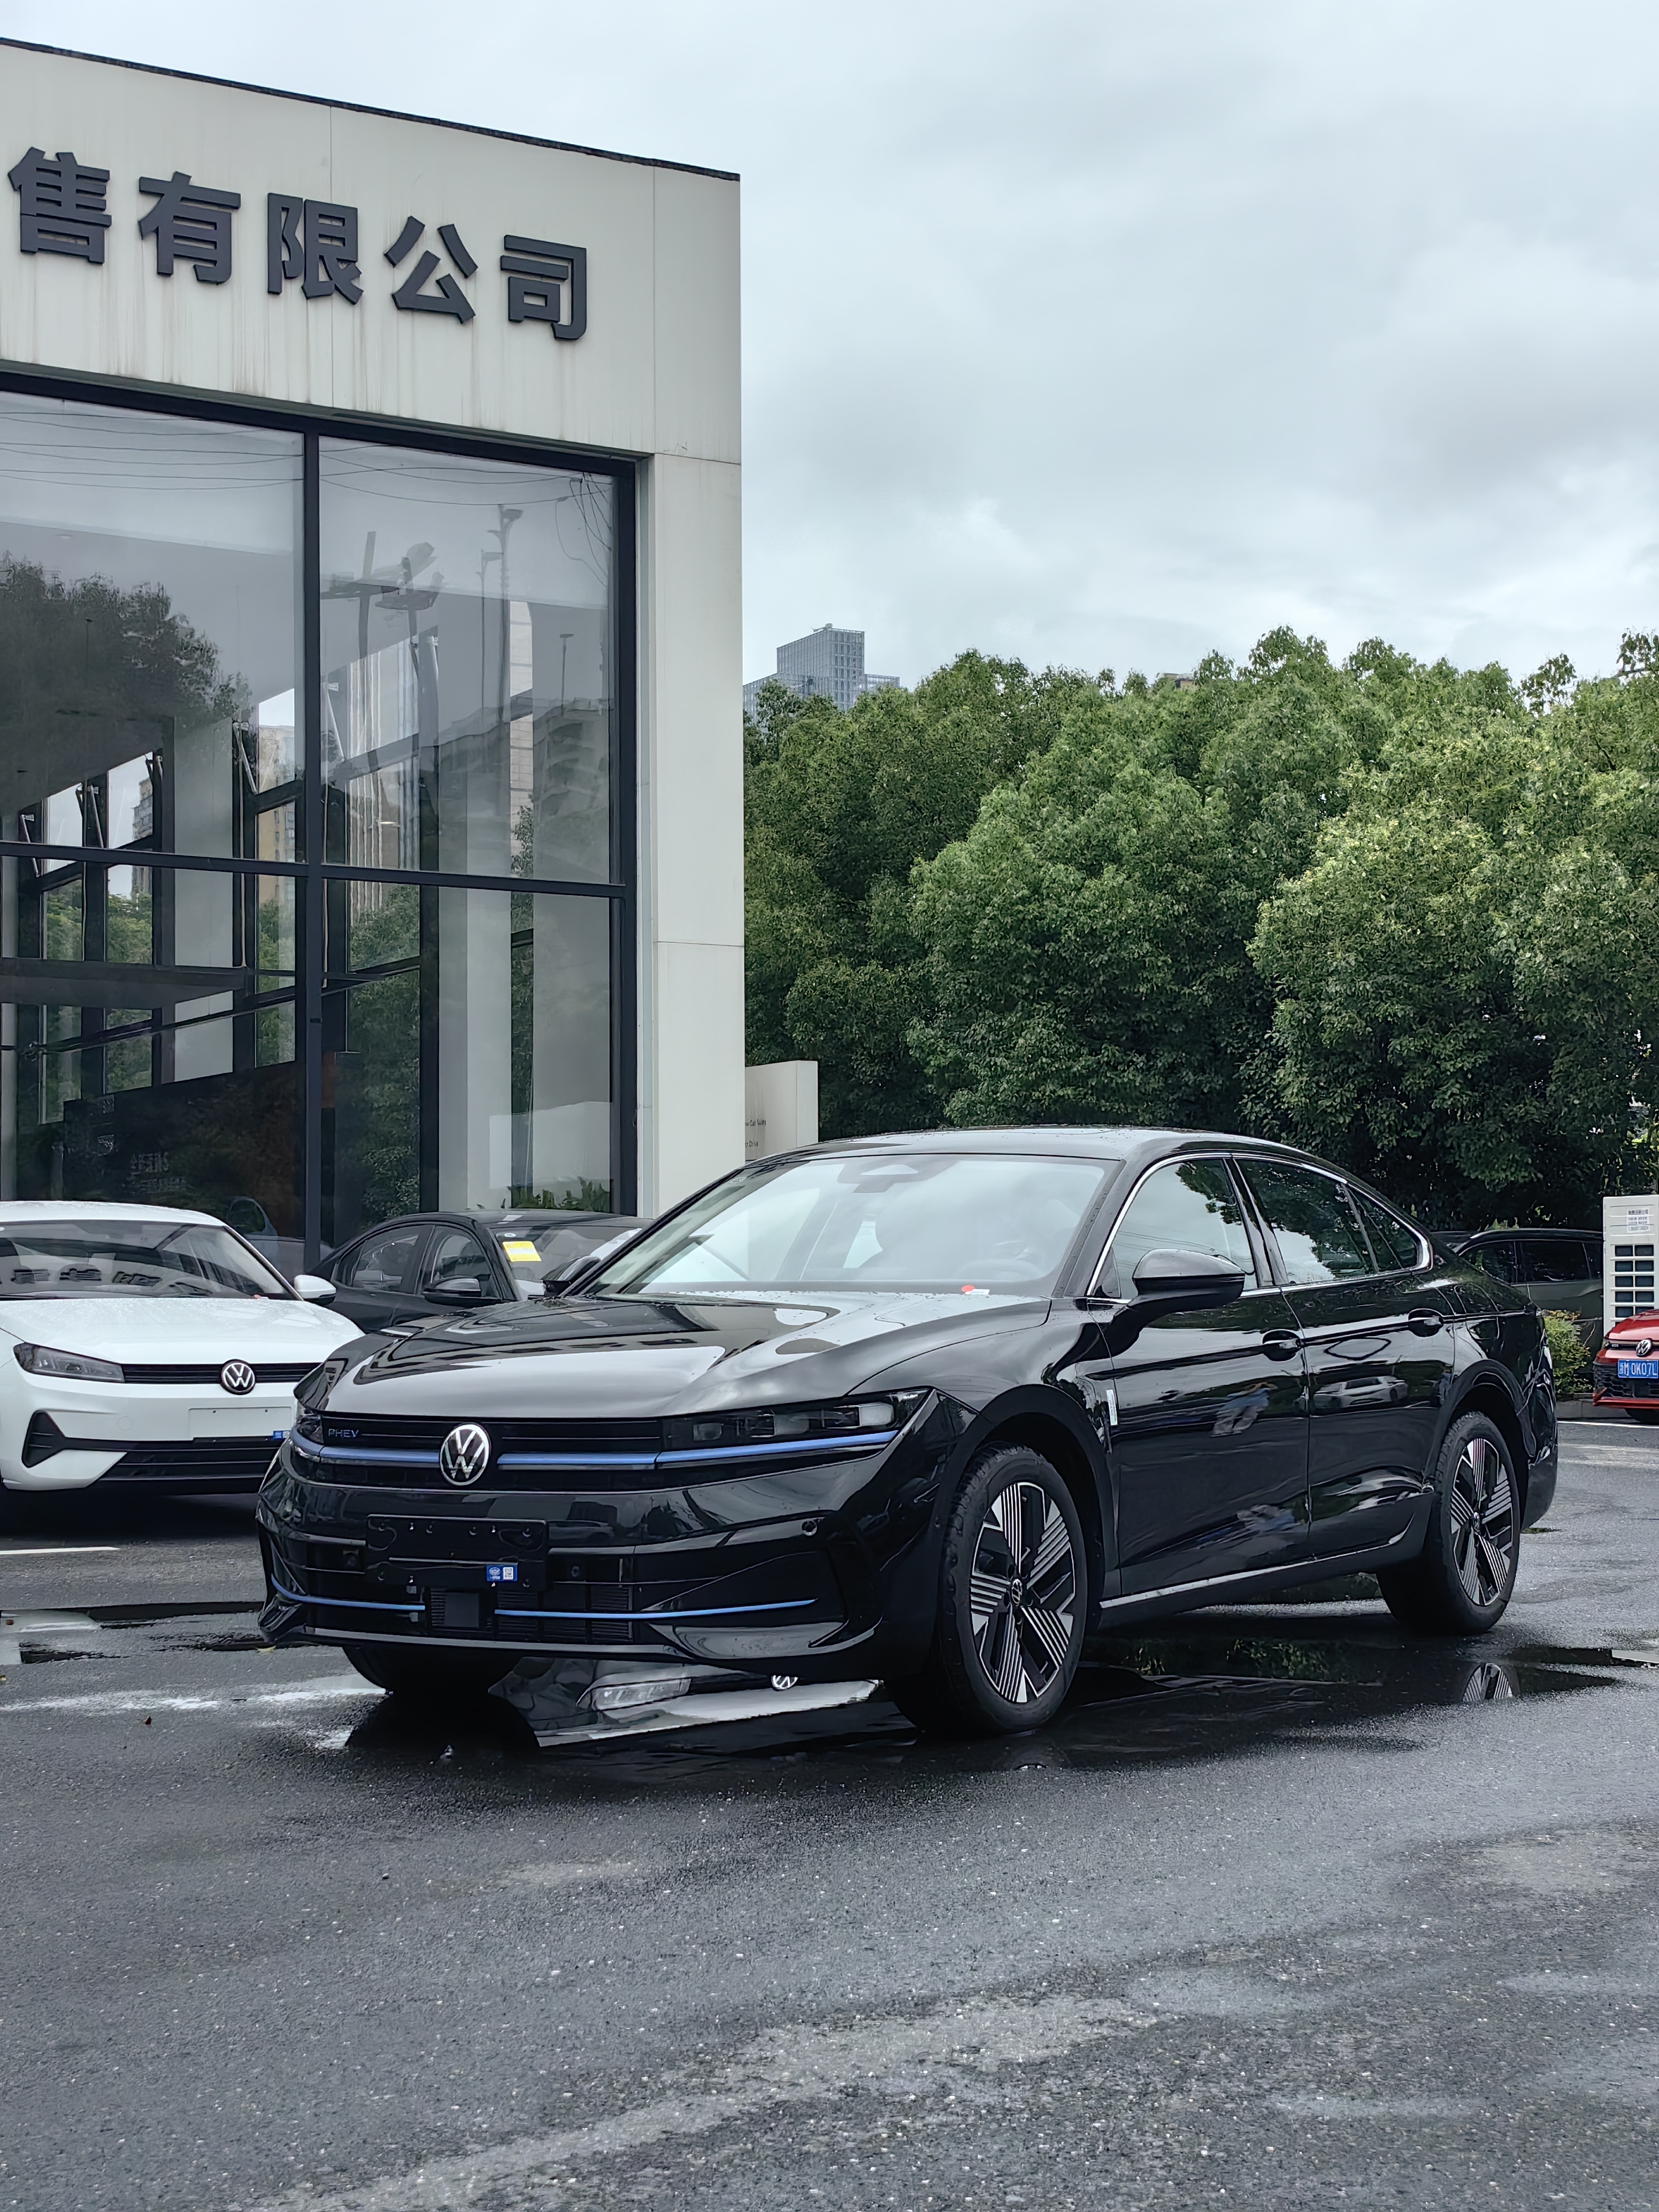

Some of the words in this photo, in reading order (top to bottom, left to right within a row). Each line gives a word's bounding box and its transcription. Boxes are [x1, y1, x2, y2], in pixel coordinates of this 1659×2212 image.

[7, 147, 587, 340] 售有限公司
[224, 1363, 254, 1390] VW
[328, 1428, 359, 1438] PHEV
[443, 1427, 486, 1481] VW
